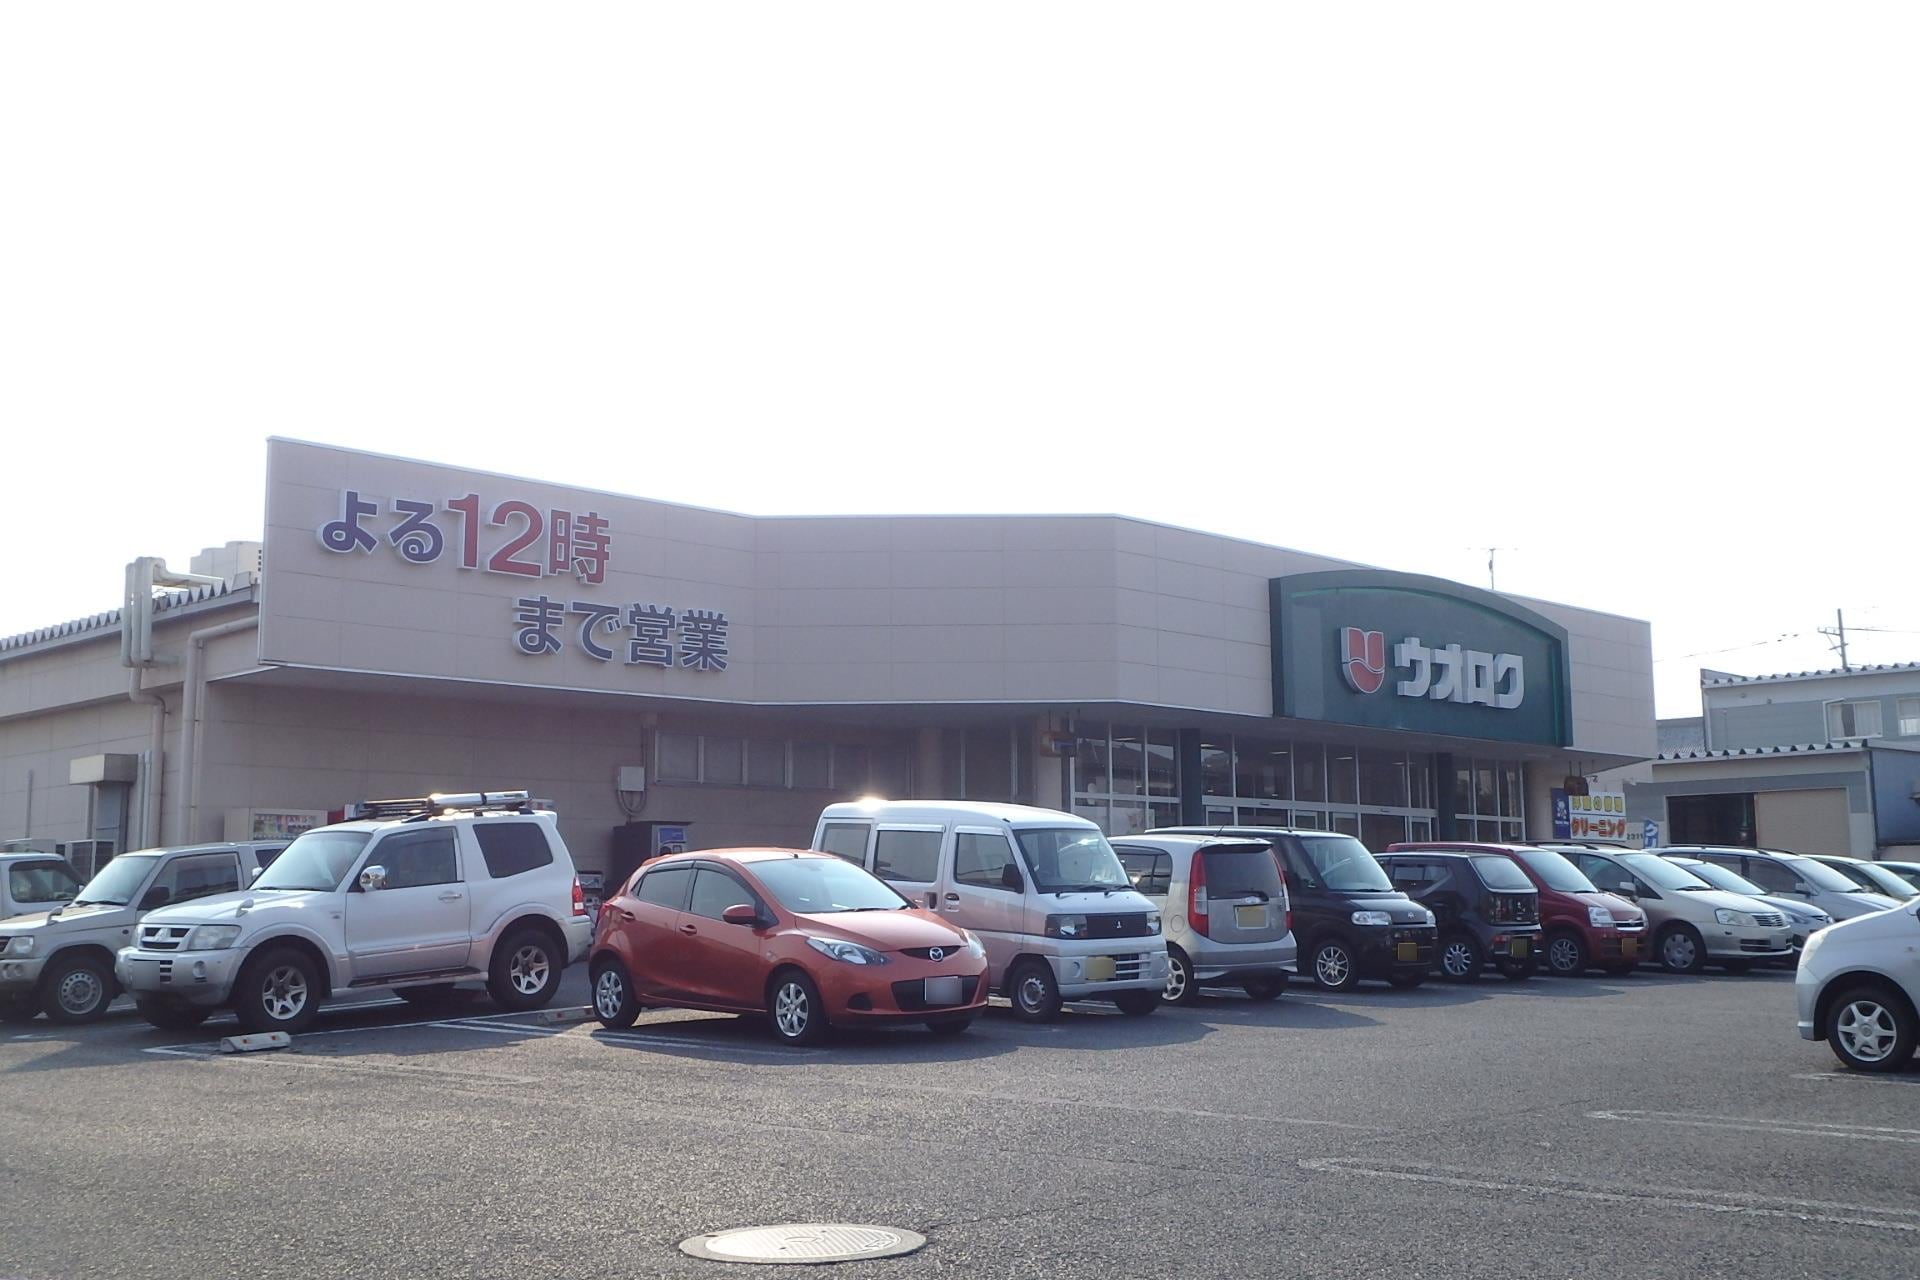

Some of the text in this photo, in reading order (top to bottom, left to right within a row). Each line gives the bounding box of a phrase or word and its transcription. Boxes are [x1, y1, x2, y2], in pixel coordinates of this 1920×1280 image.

[318, 490, 611, 584] よる12時
[513, 595, 729, 671] まで営業
[1394, 637, 1525, 709] ウオロク
[1572, 817, 1625, 838] クリーニング
